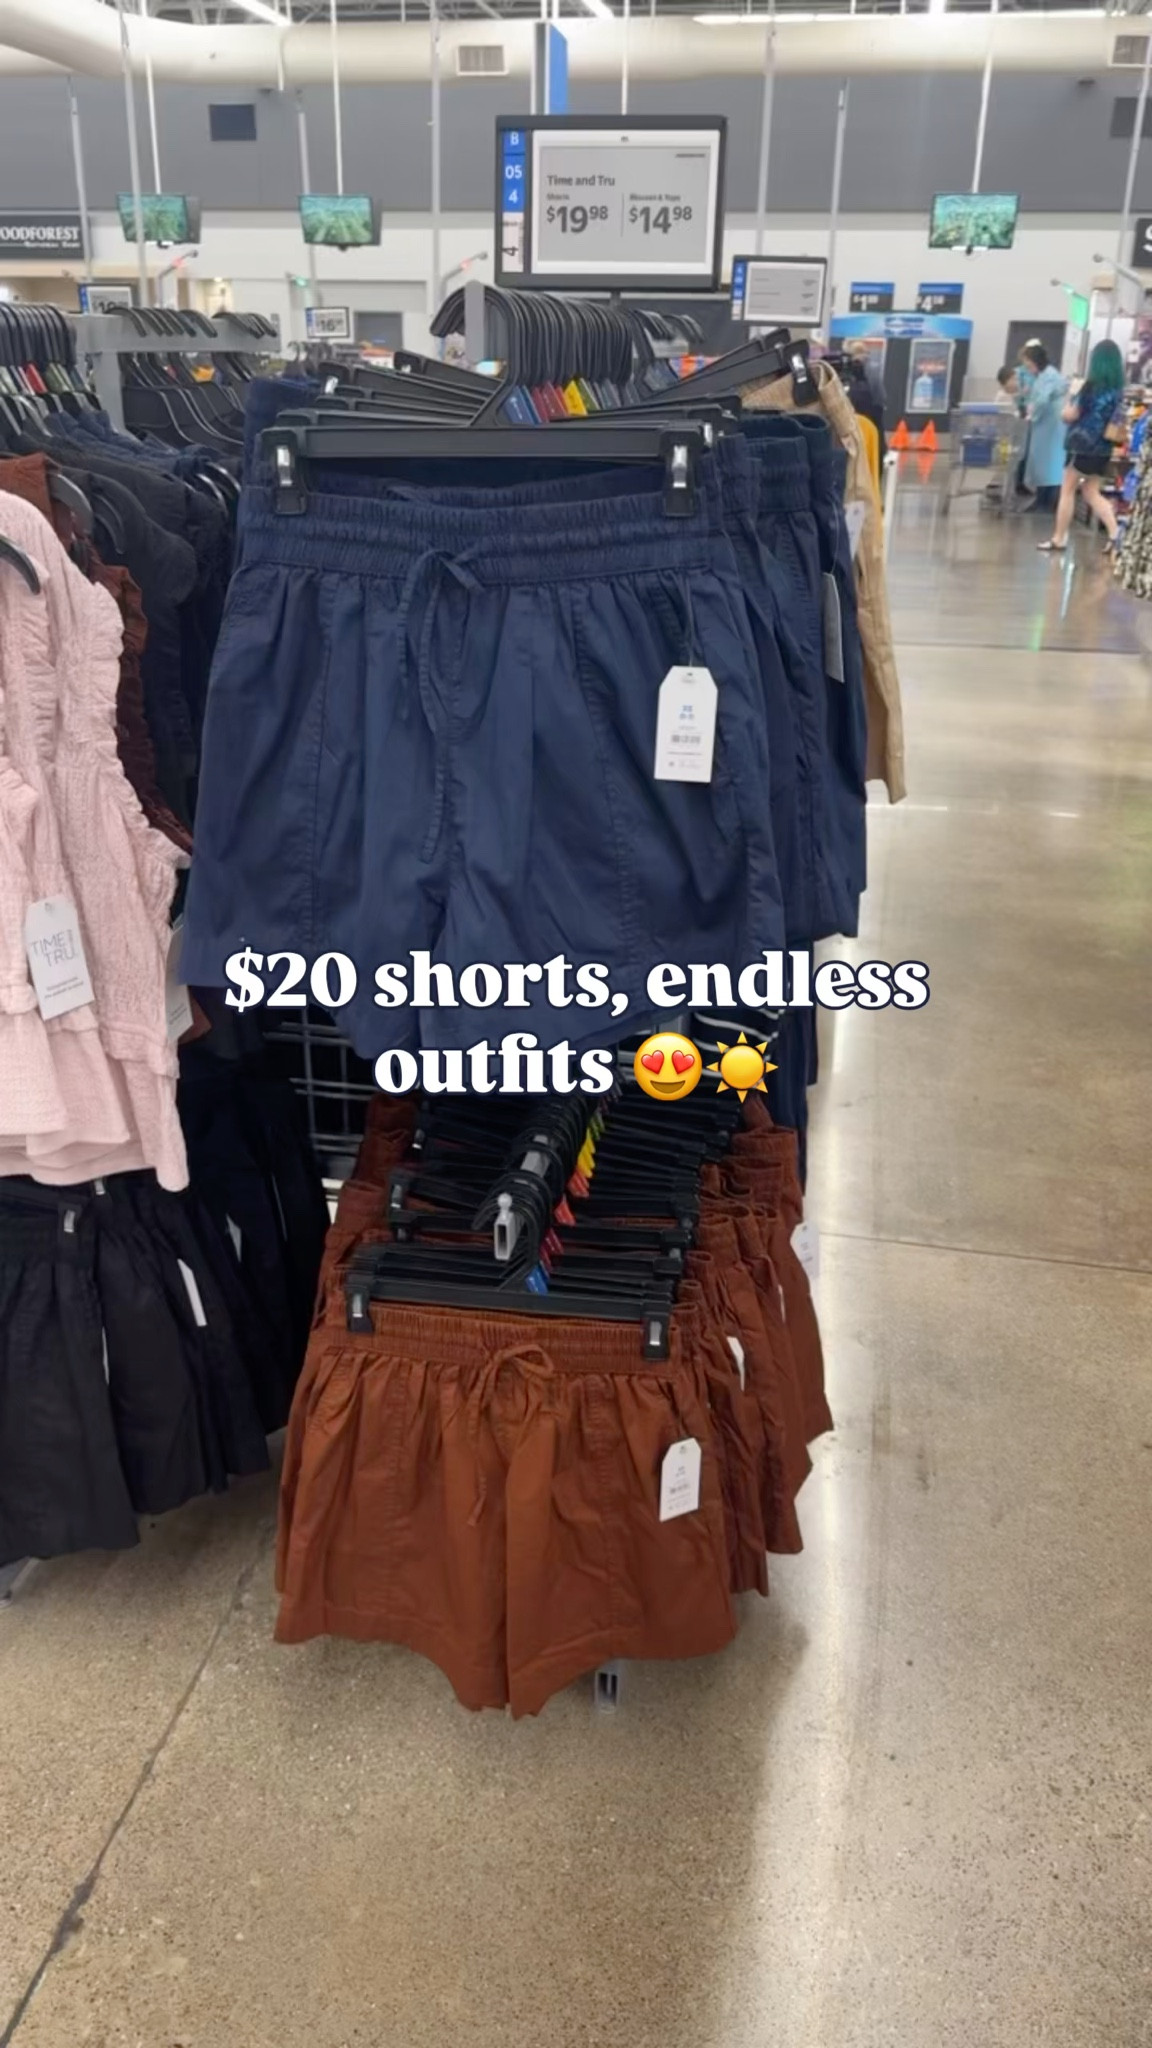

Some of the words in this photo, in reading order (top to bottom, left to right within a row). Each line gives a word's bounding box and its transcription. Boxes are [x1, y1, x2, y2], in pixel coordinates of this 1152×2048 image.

[510, 132, 519, 146] B
[505, 165, 523, 179] 05
[547, 175, 573, 187] Time
[575, 175, 595, 187] and
[598, 175, 615, 187] Tru
[508, 189, 518, 203] 4
[0, 226, 79, 240] OODFOREST
